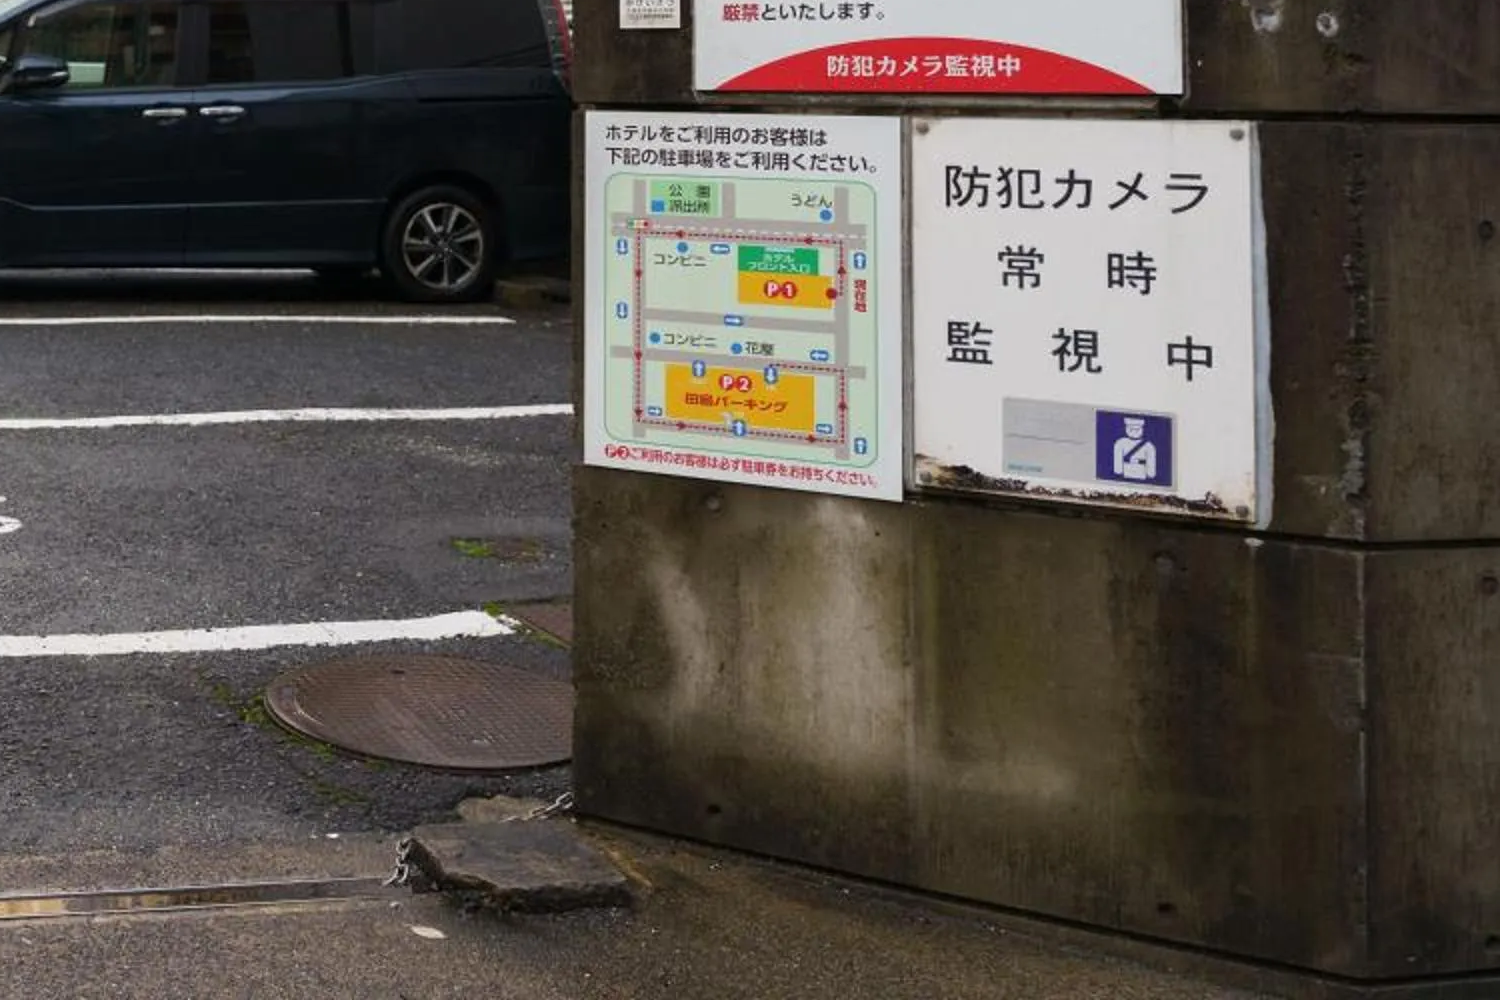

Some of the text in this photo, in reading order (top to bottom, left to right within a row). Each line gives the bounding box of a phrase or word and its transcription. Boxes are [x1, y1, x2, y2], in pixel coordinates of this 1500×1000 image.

[722, 0, 886, 23] 厳禁といたします。
[826, 53, 1022, 79] 防犯カメラ監視中
[605, 125, 828, 147] ホテルをご利用のお客様は
[605, 147, 878, 174] 下記の駐車場をご利用ください。
[944, 164, 1209, 215] 防犯カメラ
[791, 193, 834, 209] うどん
[653, 253, 707, 267] コンビニ
[663, 333, 718, 348] コンビニ
[744, 341, 775, 356] 花屋
